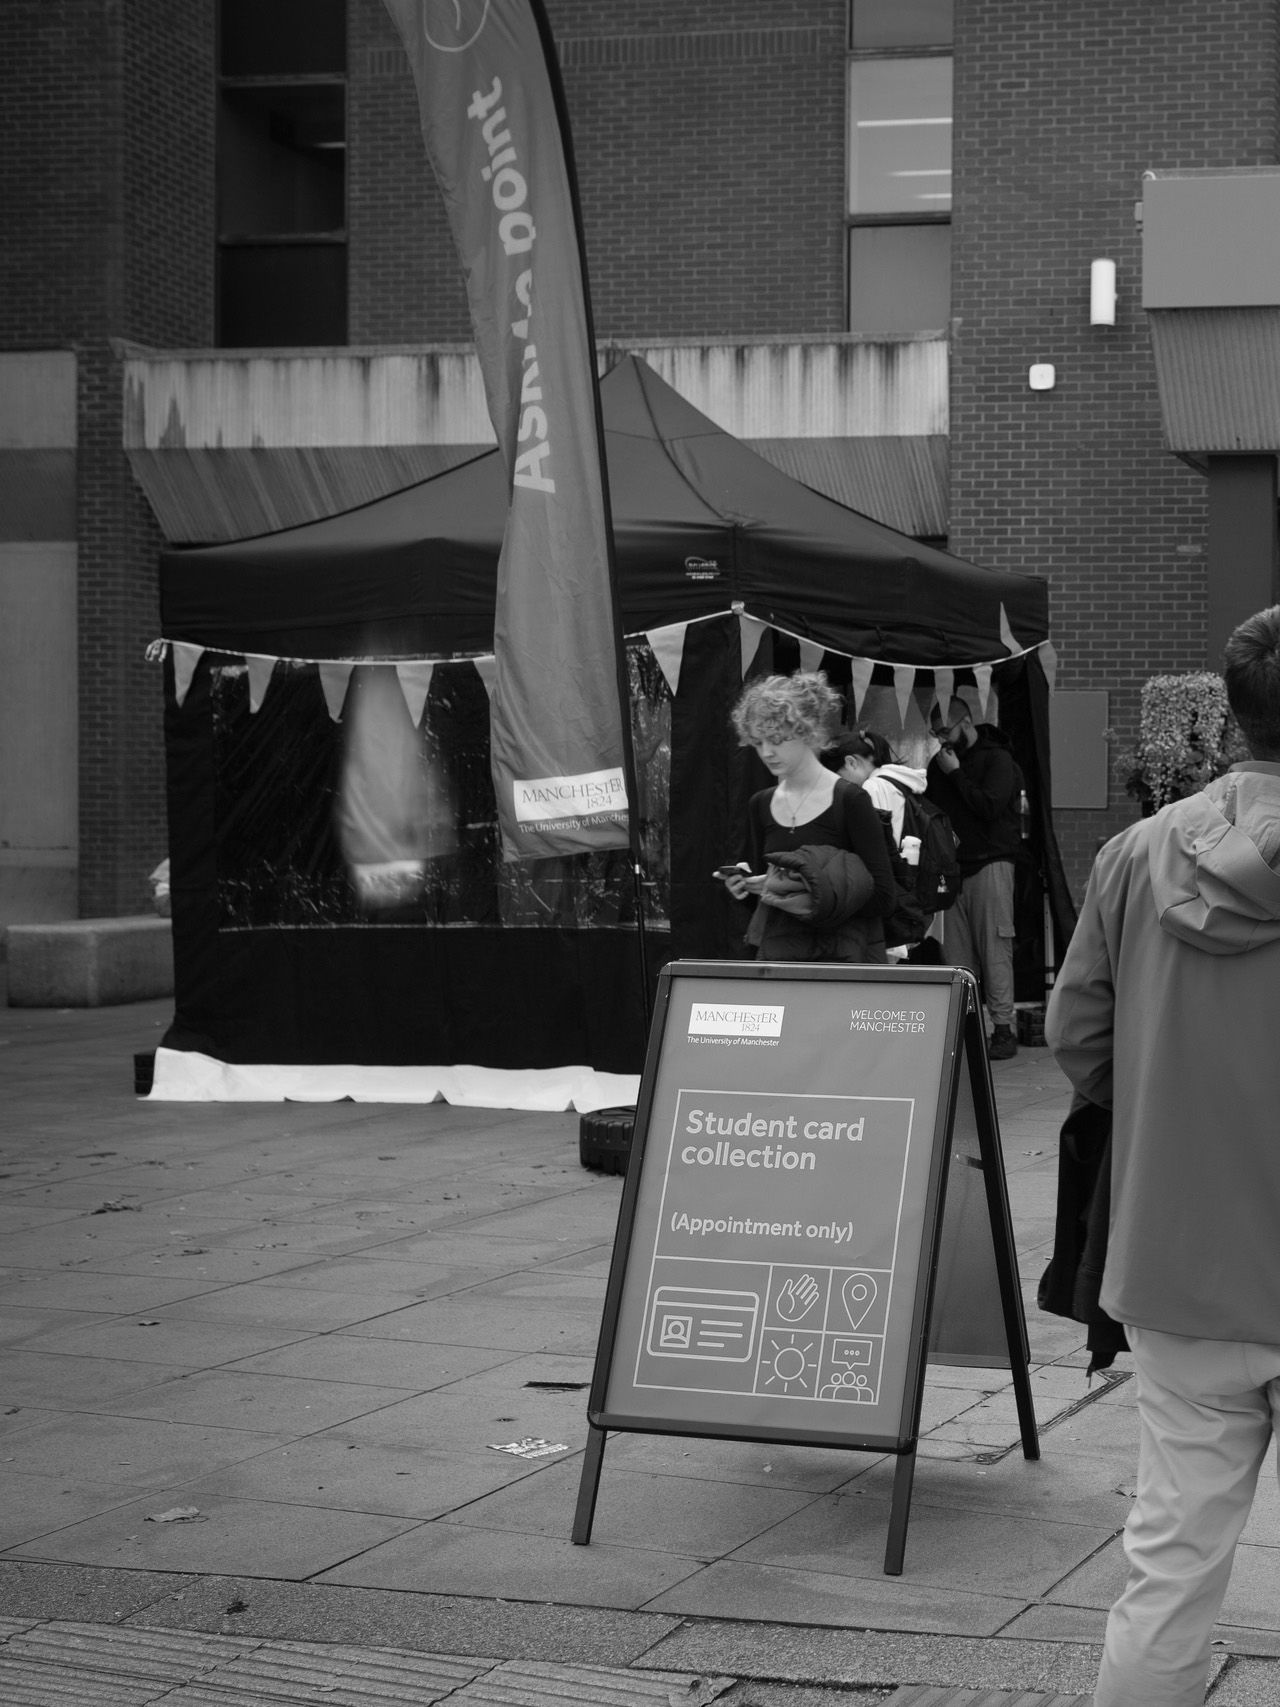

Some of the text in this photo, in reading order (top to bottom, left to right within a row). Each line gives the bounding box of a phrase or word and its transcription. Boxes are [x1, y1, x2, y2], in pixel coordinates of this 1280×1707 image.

[467, 76, 536, 256] point
[523, 778, 624, 803] MANCHESTER
[587, 795, 612, 808] 1824
[520, 823, 535, 833] The
[535, 816, 581, 832] University
[696, 1010, 778, 1023] MANCHESTER
[851, 1009, 926, 1022] WELCOME TO
[741, 1023, 760, 1032] 1824
[849, 1021, 925, 1033] MANCHESTER
[687, 1035, 780, 1047] The University of Manchester
[685, 1109, 865, 1142] Student card
[681, 1141, 816, 1170] collection
[671, 1211, 854, 1244] (Appointment only)
